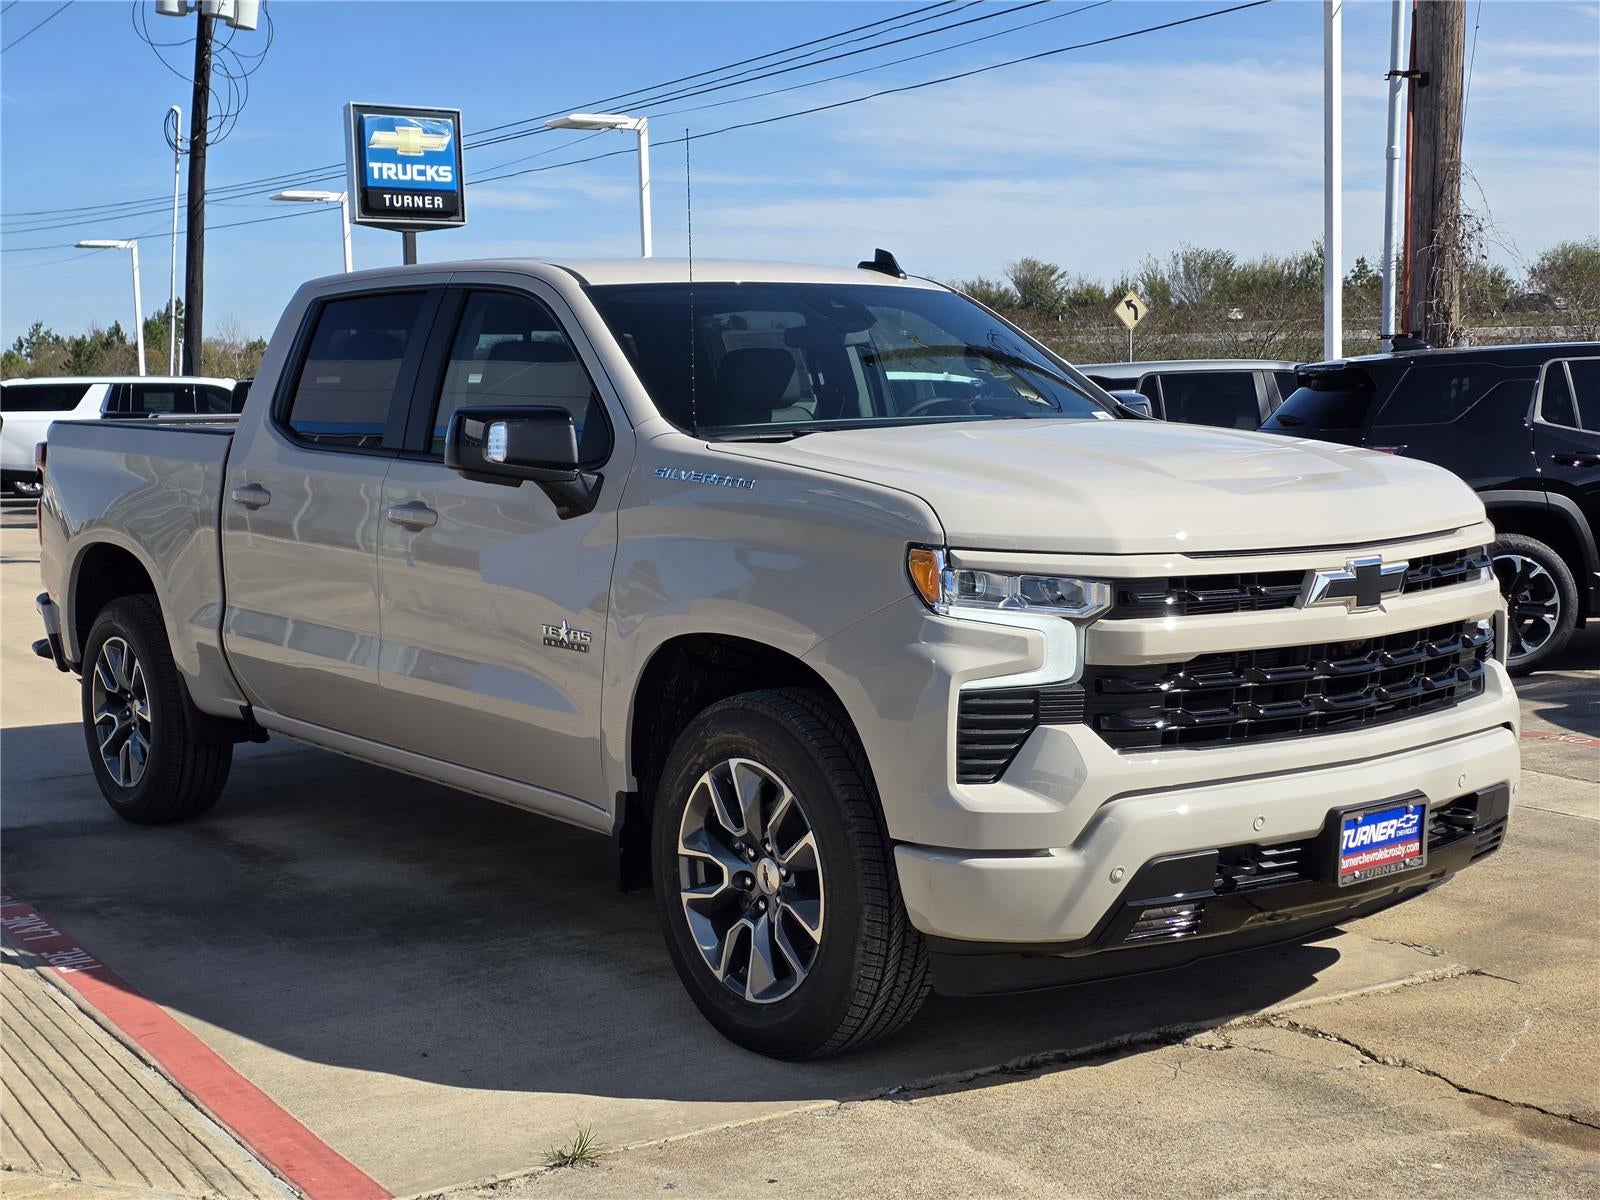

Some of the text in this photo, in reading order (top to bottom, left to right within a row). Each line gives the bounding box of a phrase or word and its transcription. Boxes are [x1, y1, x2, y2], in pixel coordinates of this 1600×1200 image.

[369, 162, 453, 182] TRUCKS
[383, 194, 443, 208] TURNER
[1342, 819, 1397, 849] TURNER
[1396, 827, 1417, 837] CHEVROLET
[1360, 862, 1405, 879] TURNER
